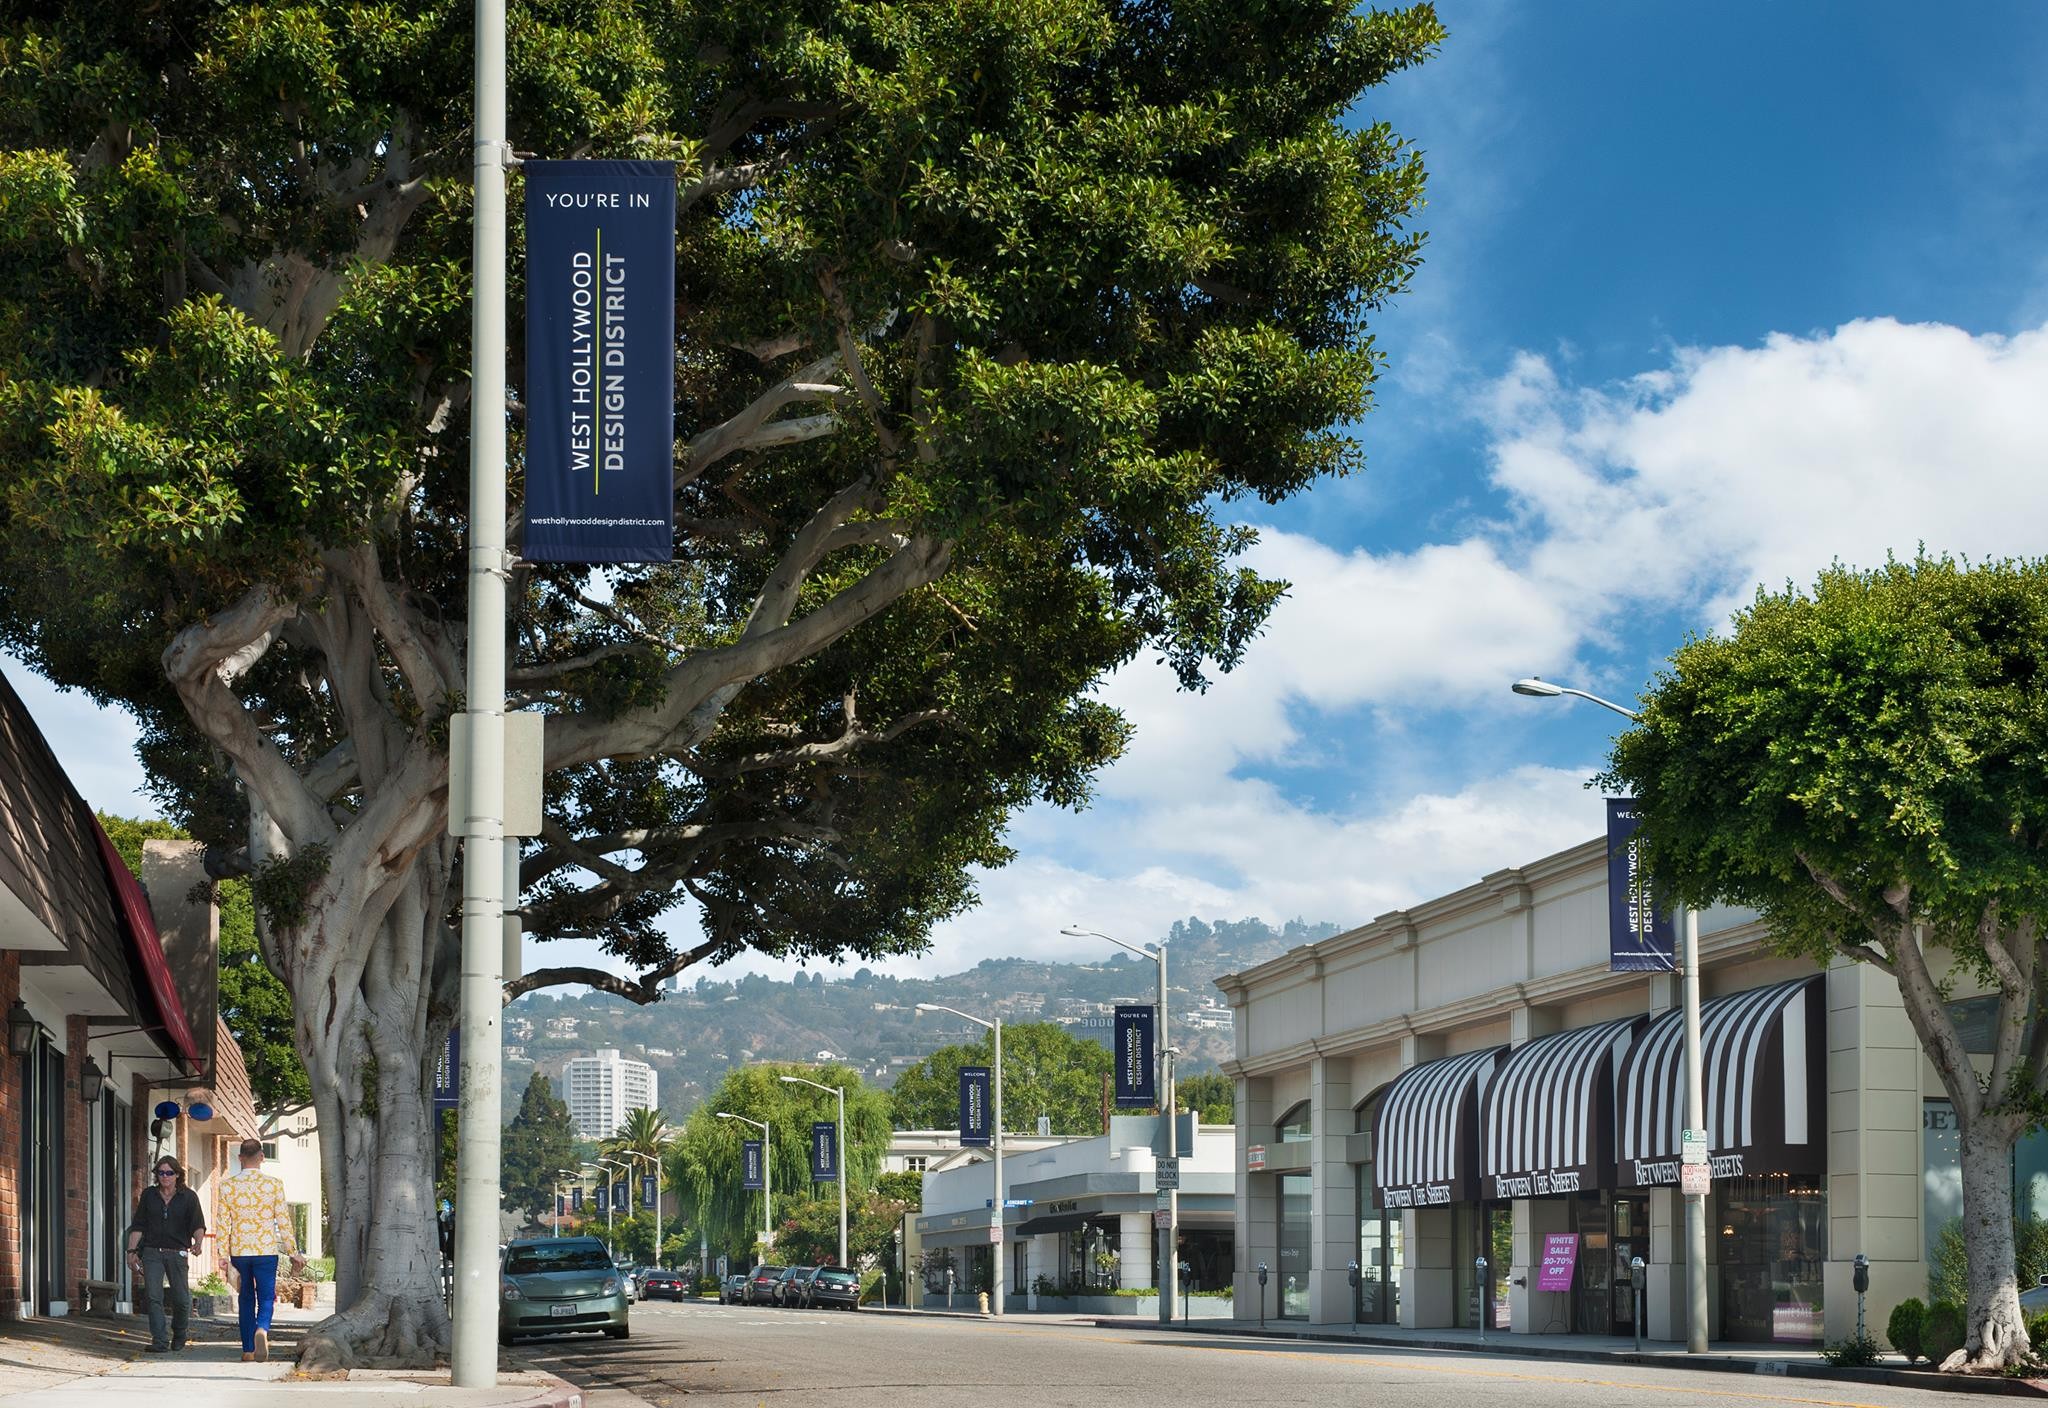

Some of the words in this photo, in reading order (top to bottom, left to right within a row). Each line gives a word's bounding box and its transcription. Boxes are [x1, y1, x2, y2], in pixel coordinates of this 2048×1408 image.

[547, 193, 619, 207] YOU'RE
[630, 193, 649, 207] IN
[606, 254, 625, 367] DISTRICT
[572, 251, 592, 404] HOLLYWOOD
[605, 375, 625, 471] DESIGN
[572, 411, 591, 471] WEST
[530, 516, 665, 527] westhollywooddesigndistrict.com
[1629, 905, 1639, 933] WEST
[1081, 1018, 1114, 1028] 9000
[1684, 1131, 1692, 1140] 2
[1157, 1160, 1166, 1169] DO
[1166, 1160, 1177, 1169] NOT
[1157, 1171, 1177, 1179] BLOCK
[1634, 1159, 1681, 1186] BETWEEN
[1495, 1175, 1532, 1199] BETWEEN
[1531, 1171, 1550, 1195] THE
[1549, 1169, 1580, 1194] SHEETS
[1383, 1187, 1412, 1209] BETWEEN
[1411, 1184, 1427, 1206] THE
[1426, 1182, 1451, 1205] SHEETS
[1550, 1236, 1574, 1245] WHITE
[1550, 1247, 1570, 1255] SALE
[1543, 1257, 1573, 1265] 20-70%
[1549, 1267, 1565, 1275] OFF
